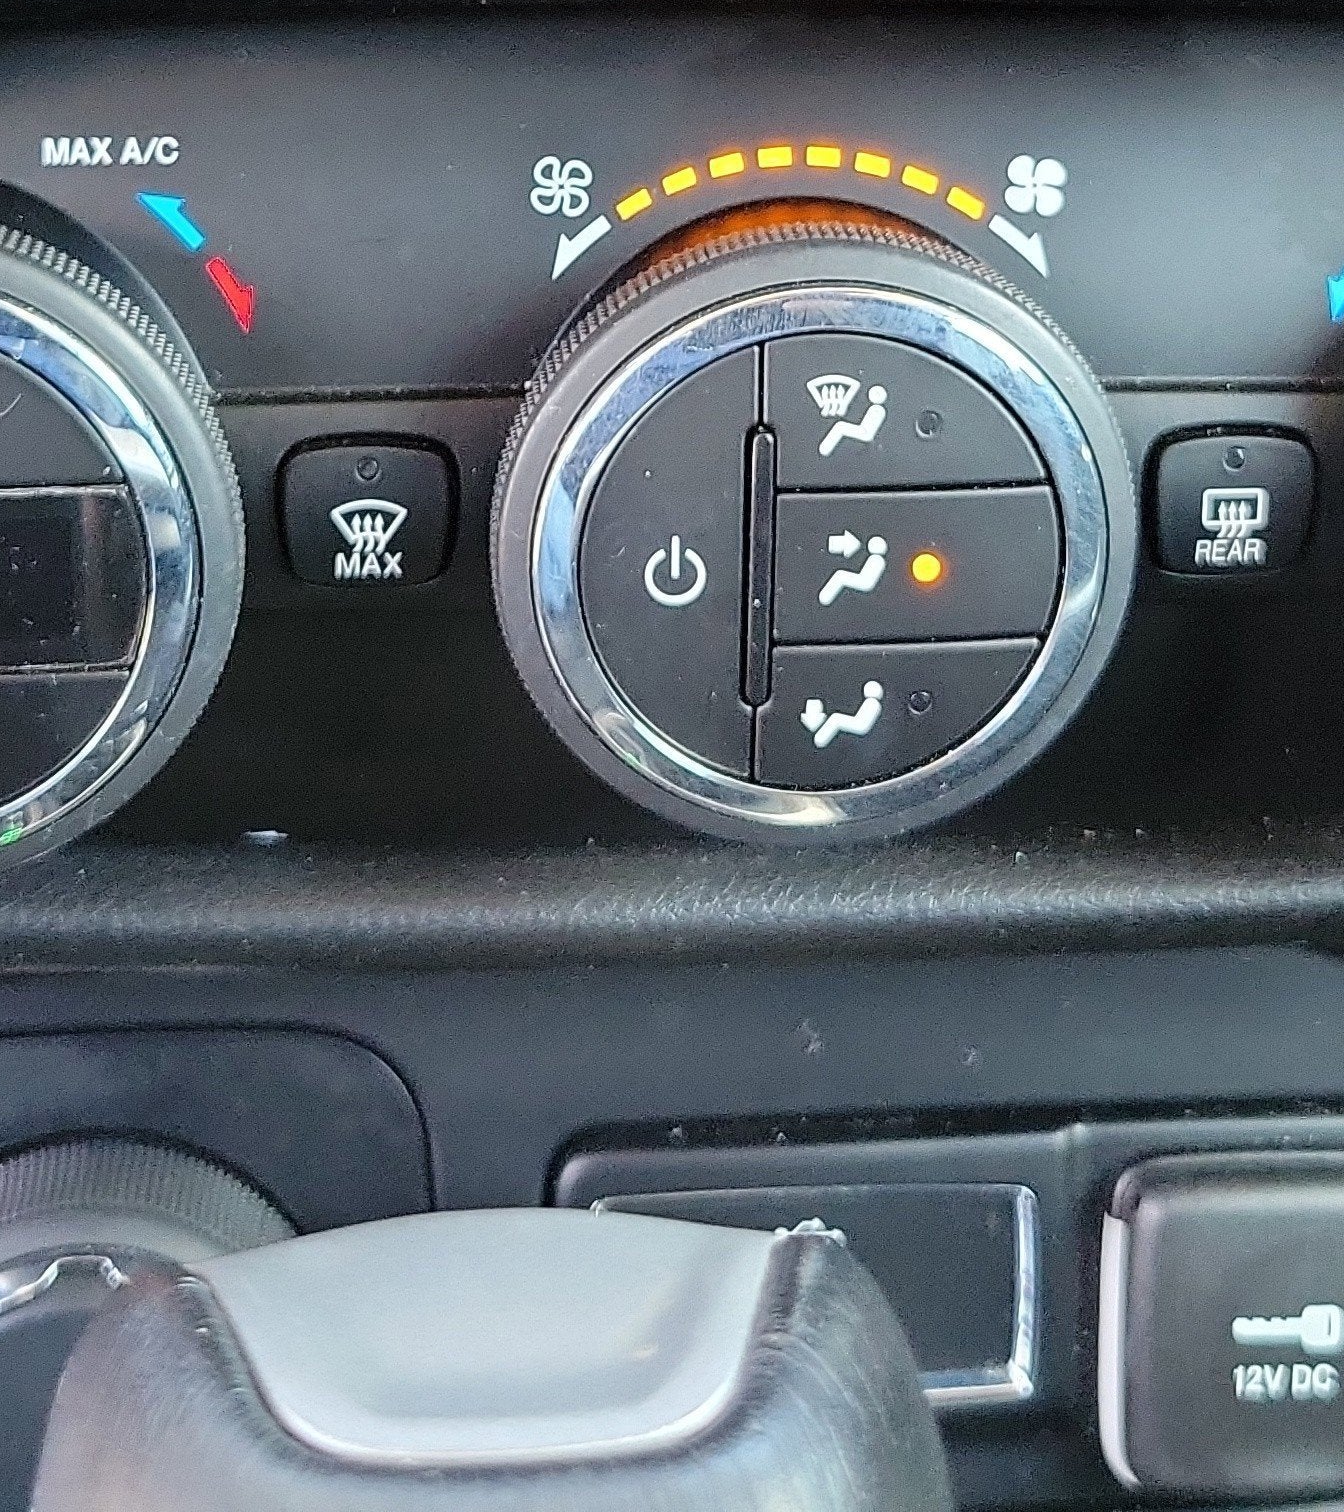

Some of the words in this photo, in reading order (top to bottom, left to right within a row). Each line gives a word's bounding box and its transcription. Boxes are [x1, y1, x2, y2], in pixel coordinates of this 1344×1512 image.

[40, 136, 113, 167] MAX
[119, 136, 179, 166] A/C
[334, 551, 403, 580] MAX
[1194, 538, 1268, 568] REAR
[1233, 1363, 1290, 1402] 12V
[1291, 1363, 1342, 1403] DC
